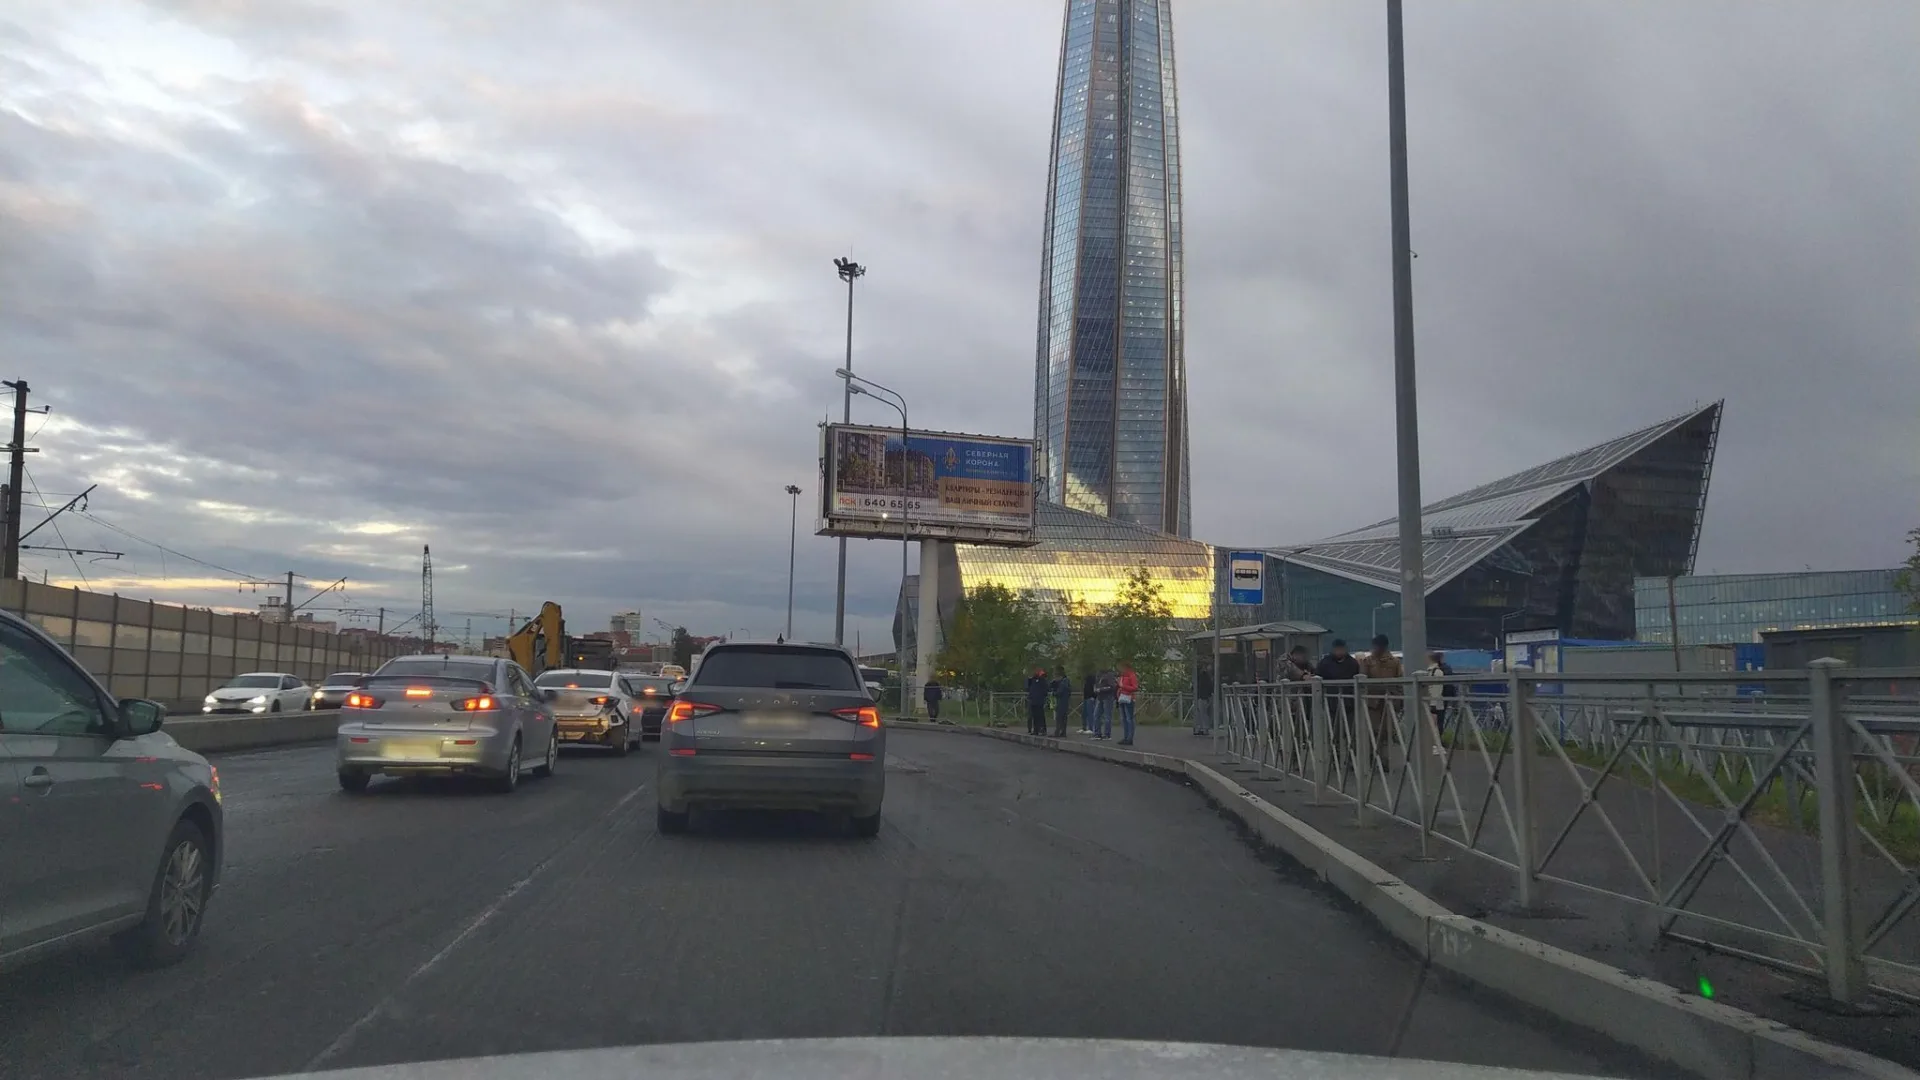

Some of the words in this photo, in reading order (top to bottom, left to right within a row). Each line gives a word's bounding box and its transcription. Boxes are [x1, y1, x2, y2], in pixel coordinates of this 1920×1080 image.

[966, 450, 1009, 459] СЕВЕРНАЯ
[965, 459, 1000, 467] КОРОНА
[864, 498, 886, 507] 640
[890, 500, 903, 509] 65
[907, 501, 921, 509] 65
